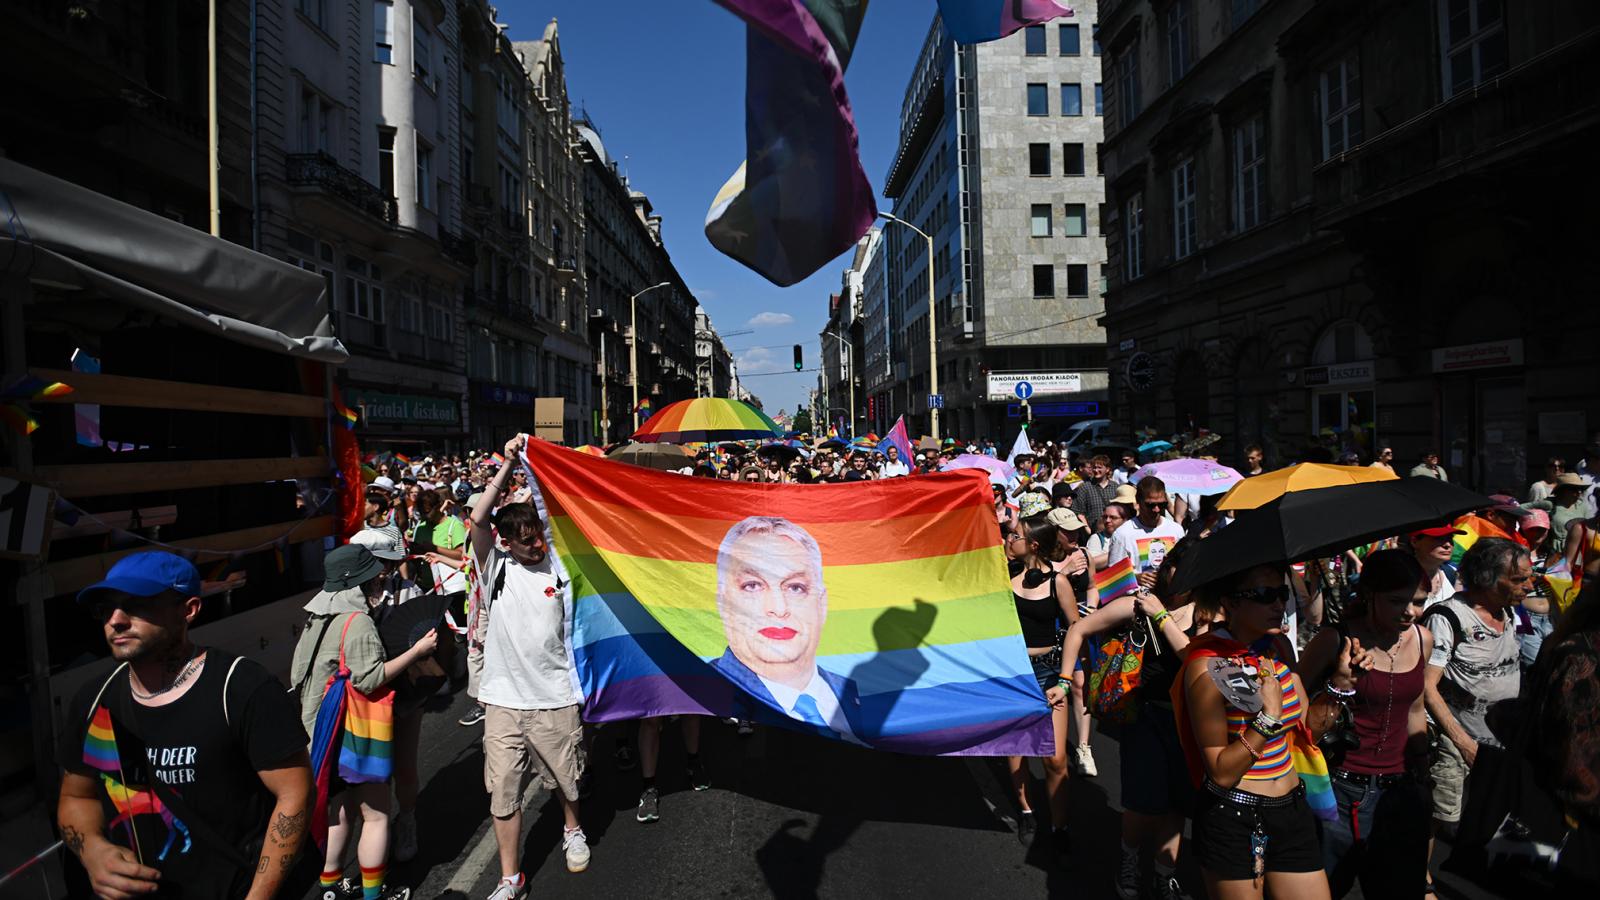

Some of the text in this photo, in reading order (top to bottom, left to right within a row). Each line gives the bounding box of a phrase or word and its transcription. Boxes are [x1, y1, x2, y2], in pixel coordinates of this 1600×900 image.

[362, 398, 408, 418] riental
[145, 746, 197, 766] H DEER
[155, 768, 196, 785] QUEER
